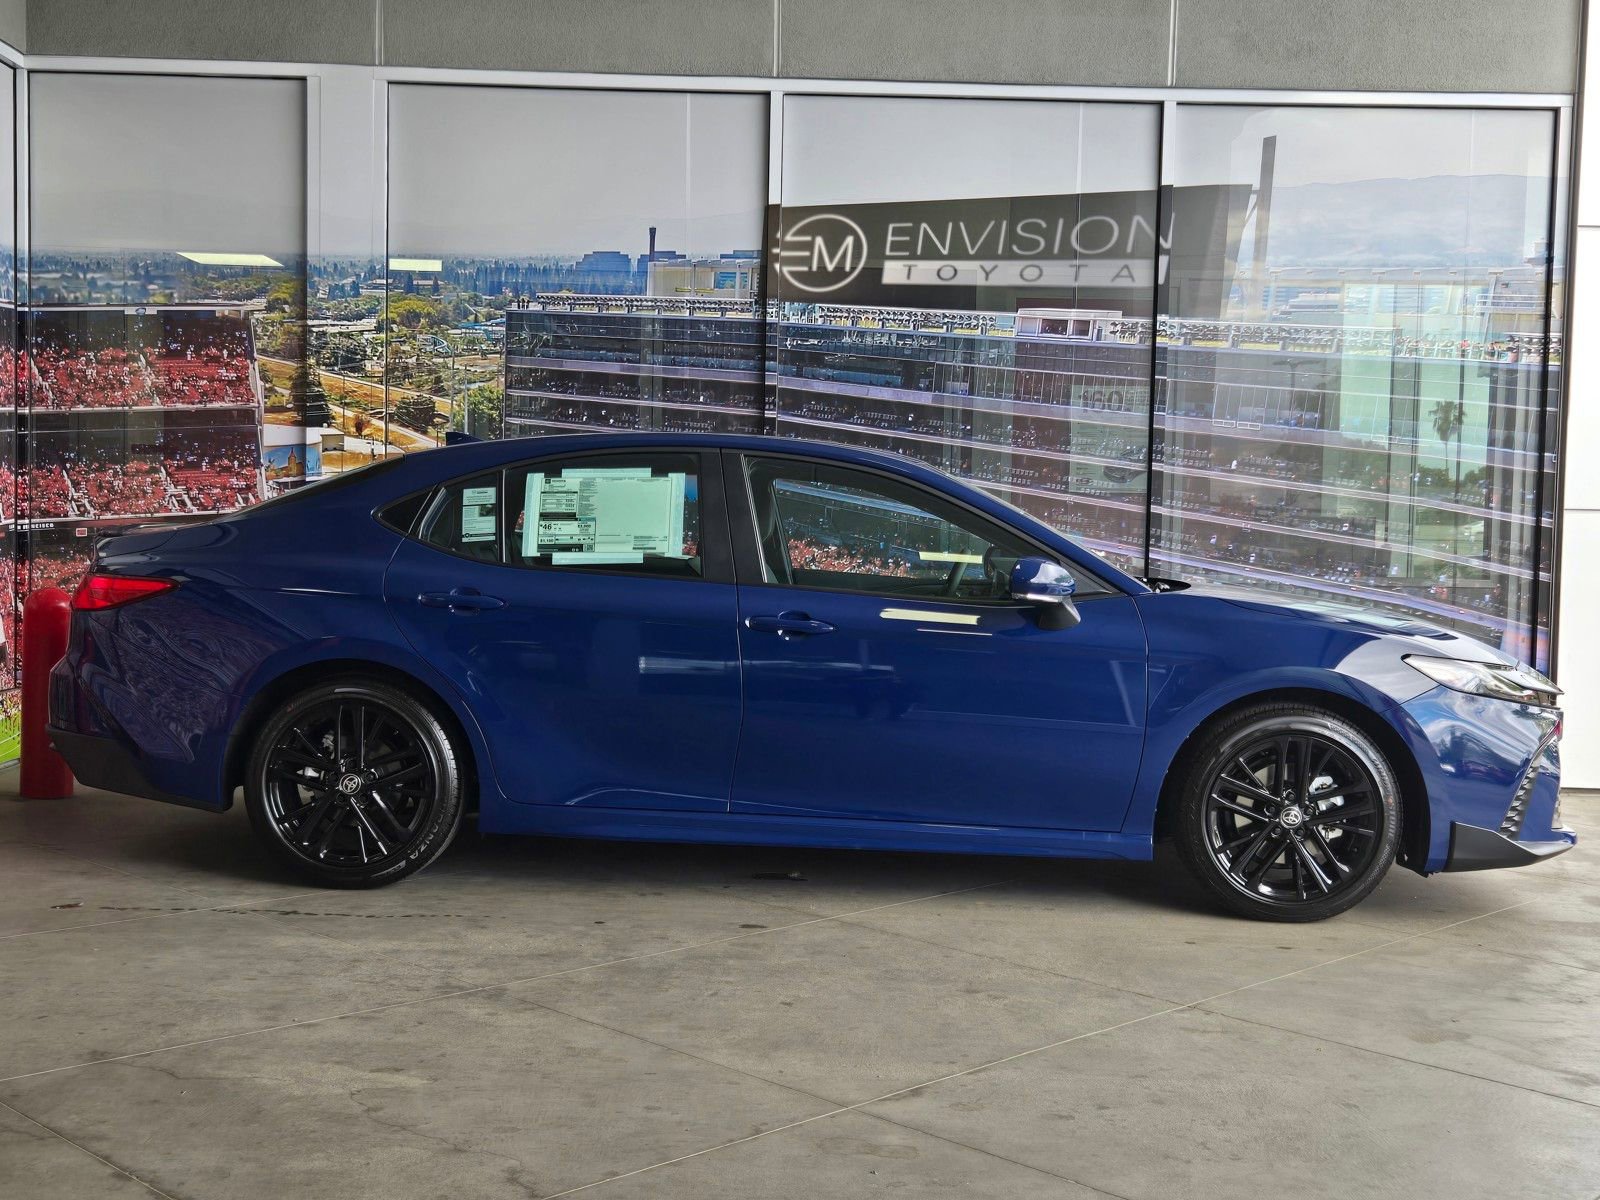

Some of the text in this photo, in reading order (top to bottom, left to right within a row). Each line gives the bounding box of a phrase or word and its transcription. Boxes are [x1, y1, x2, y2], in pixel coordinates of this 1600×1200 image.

[885, 212, 1175, 256] ENVISION
[901, 263, 1136, 283] TOYOTA
[409, 797, 449, 860] URANZA
